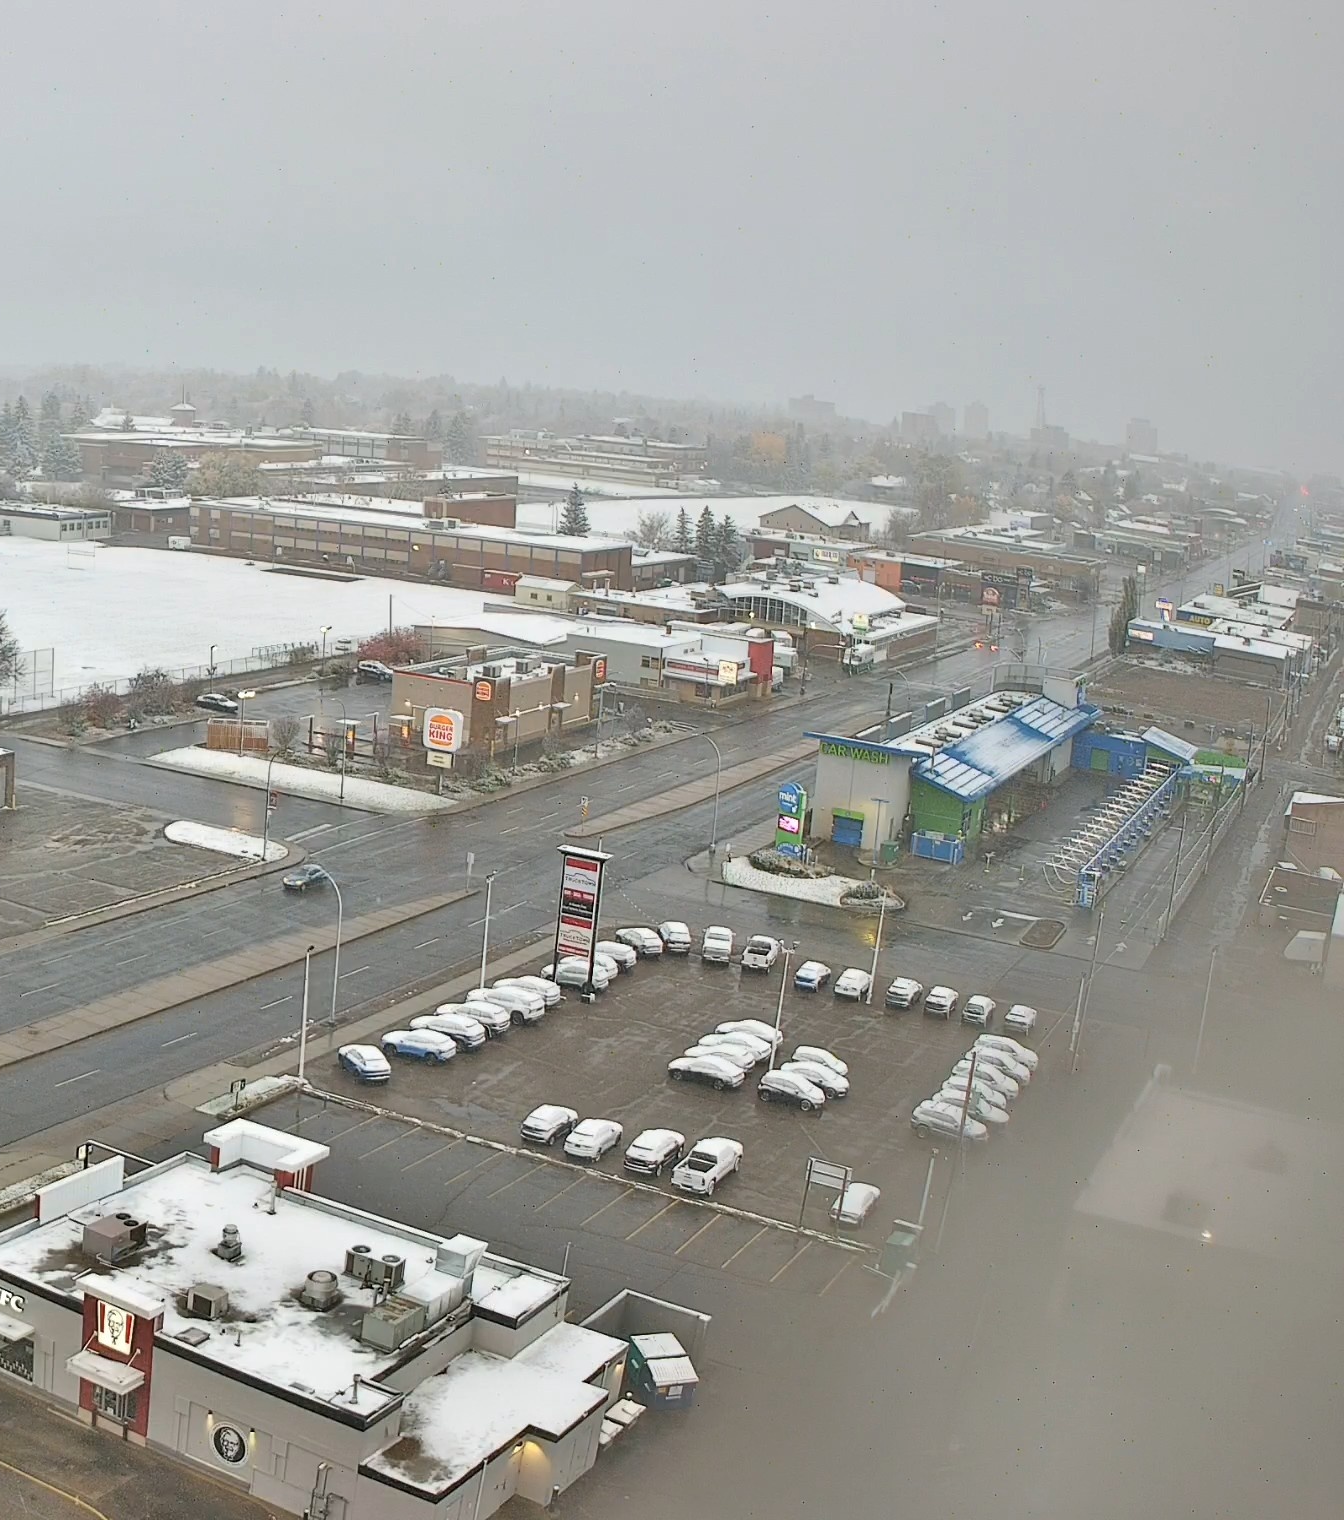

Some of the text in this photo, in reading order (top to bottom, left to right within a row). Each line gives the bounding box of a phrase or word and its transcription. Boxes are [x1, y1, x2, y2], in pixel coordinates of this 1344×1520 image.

[429, 723, 453, 732] BURGER
[429, 730, 453, 741] KING
[820, 742, 890, 764] CAR WASH
[779, 791, 797, 803] mint
